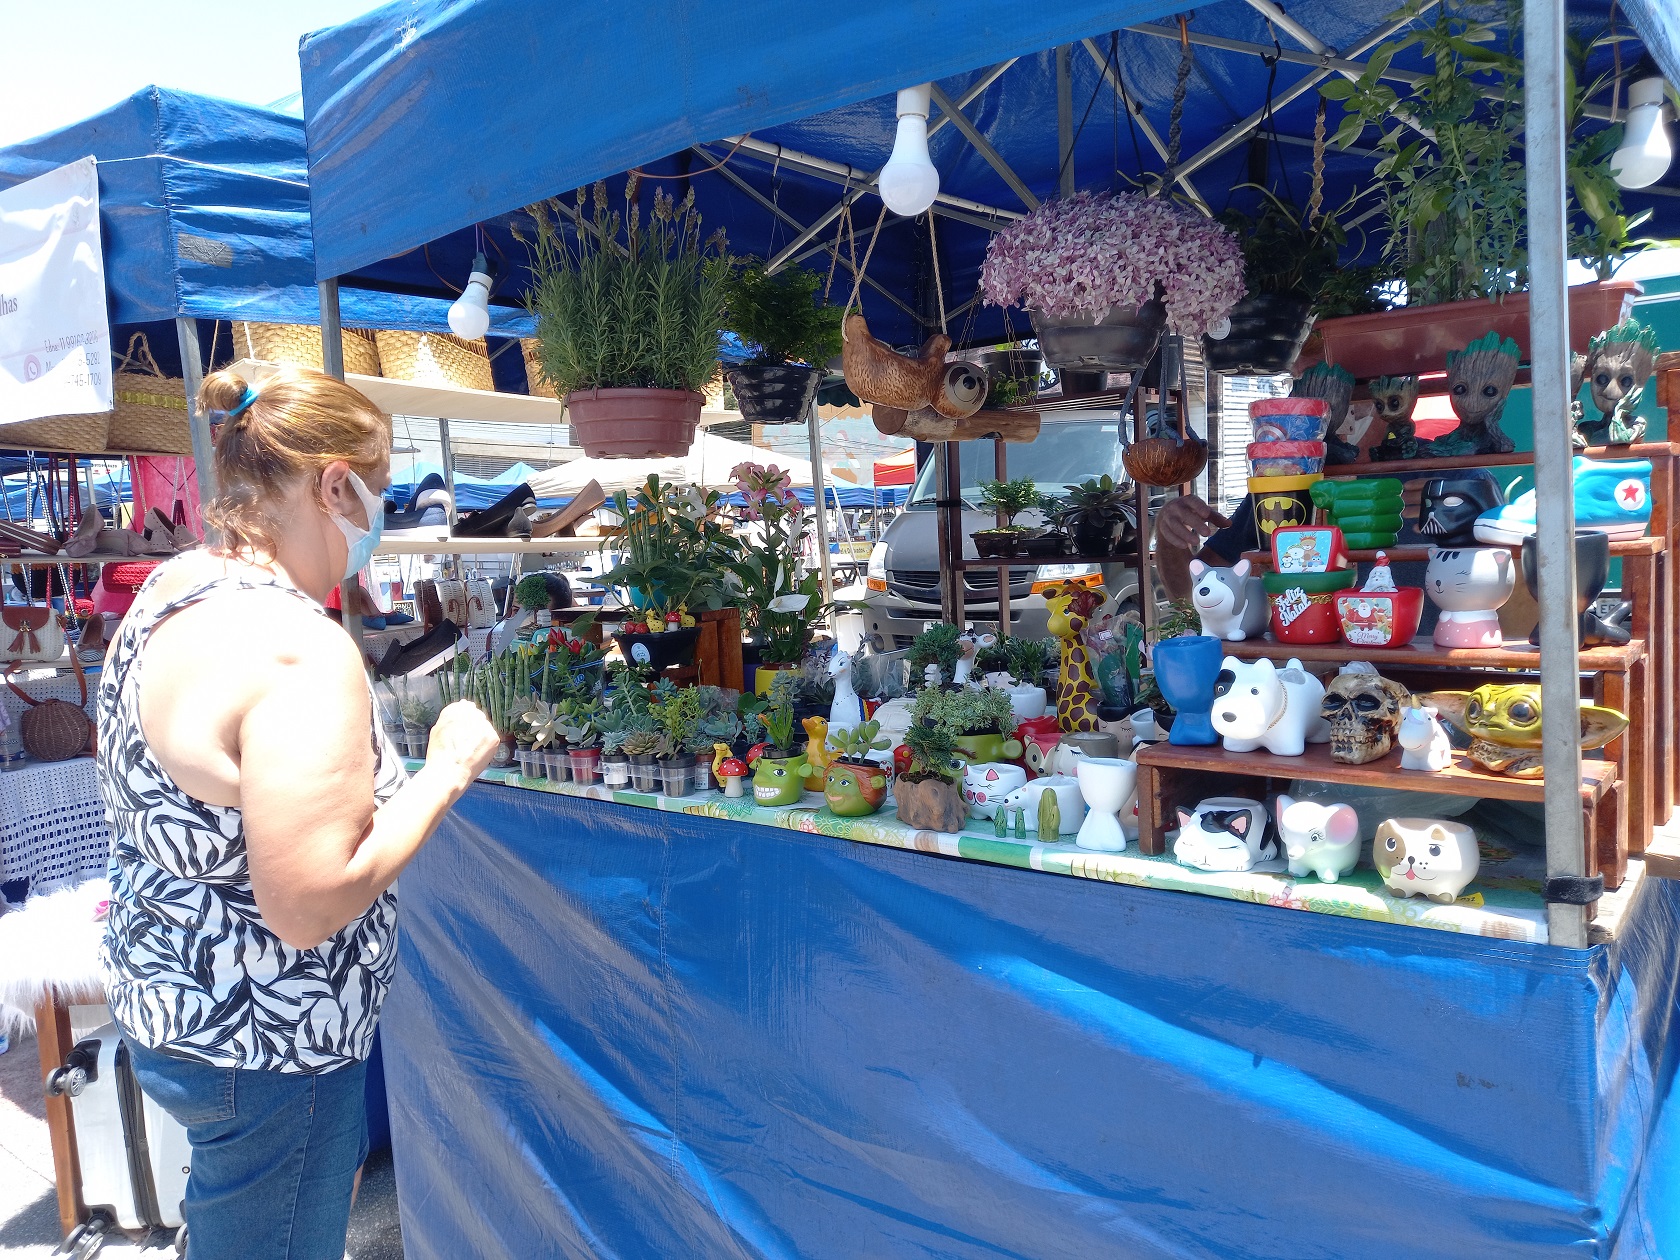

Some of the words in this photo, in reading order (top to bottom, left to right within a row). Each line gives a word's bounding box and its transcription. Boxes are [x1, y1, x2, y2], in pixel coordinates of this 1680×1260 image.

[1275, 586, 1304, 612] Feliz
[1280, 593, 1312, 627] Natal
[1357, 631, 1378, 640] Merry
